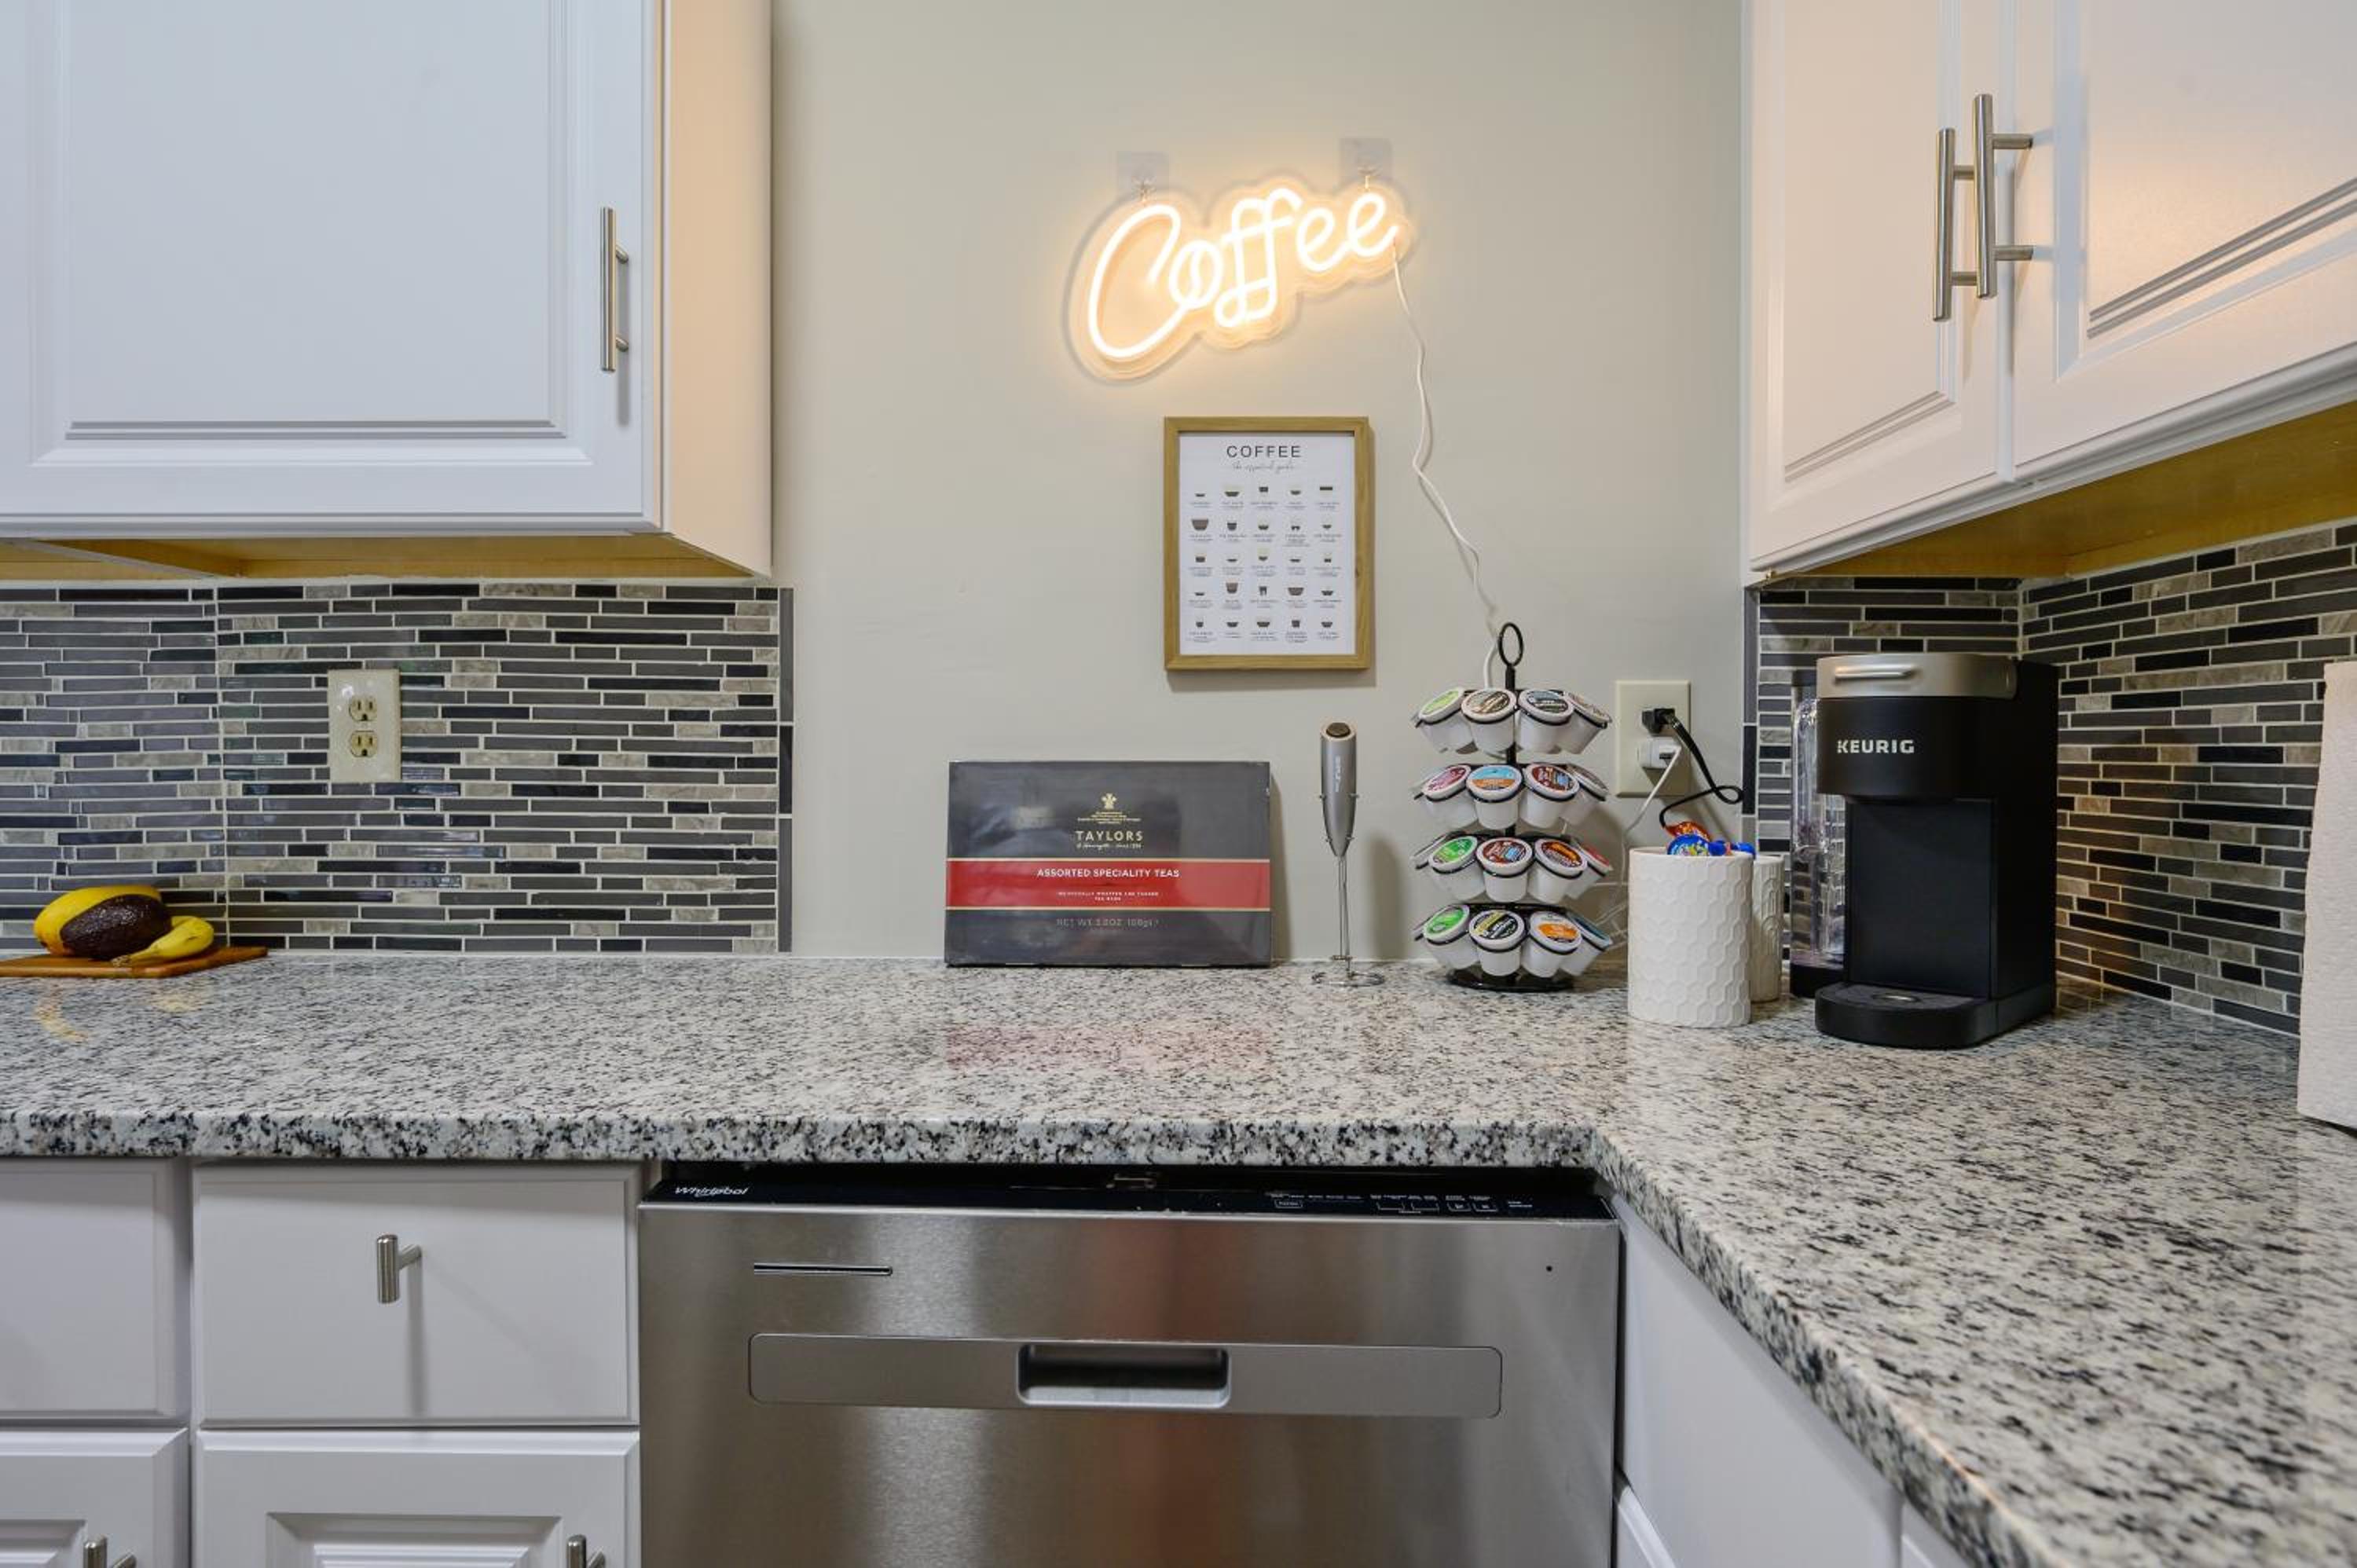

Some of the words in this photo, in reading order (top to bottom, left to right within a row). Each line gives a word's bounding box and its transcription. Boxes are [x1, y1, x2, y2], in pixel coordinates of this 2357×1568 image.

[1088, 188, 1399, 359] Coffee
[1226, 445, 1301, 457] COFFEE
[1837, 739, 1915, 754] KEURIG
[1075, 830, 1143, 841] TAYLORS
[1036, 868, 1091, 877] ASSORTED
[1093, 868, 1151, 877] SPECIALITY
[1154, 868, 1180, 877] TEAS
[675, 1186, 750, 1198] Whirlpool
